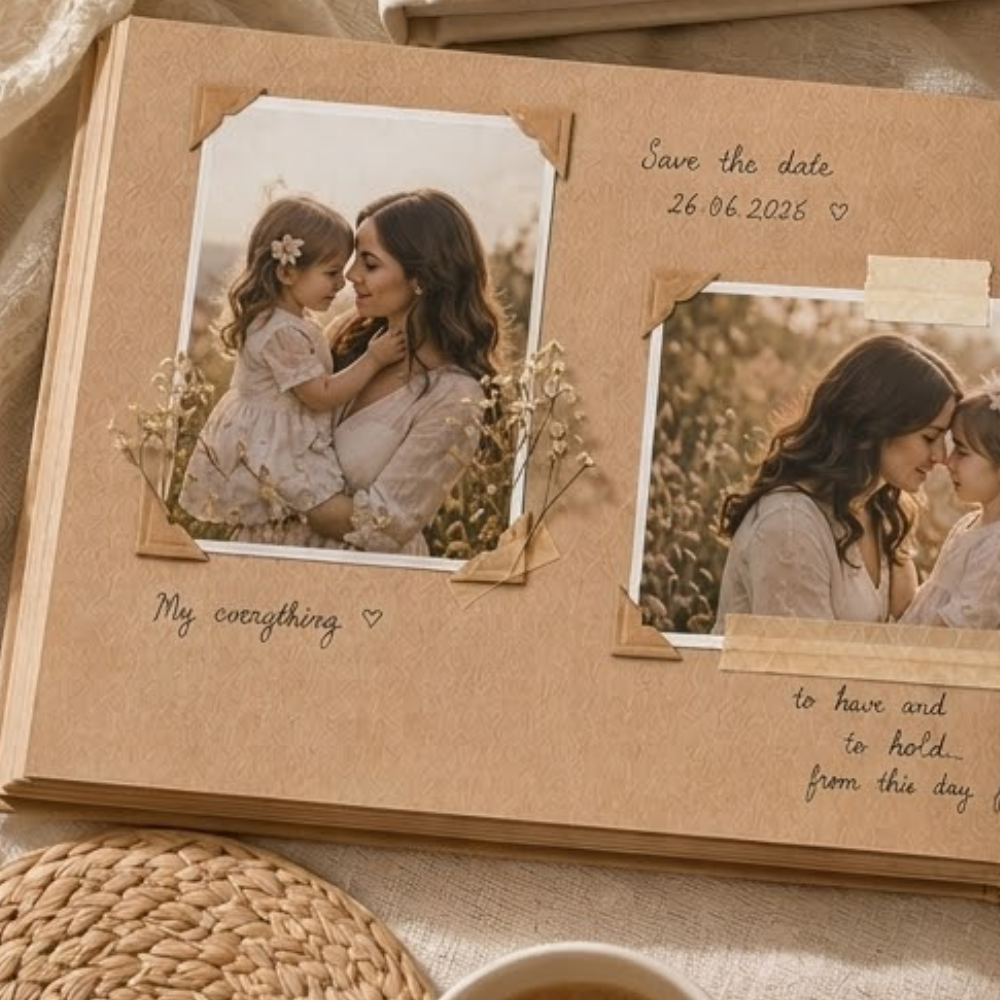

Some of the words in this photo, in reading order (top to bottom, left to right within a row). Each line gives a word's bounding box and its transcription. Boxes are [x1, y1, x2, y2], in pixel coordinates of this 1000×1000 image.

[641, 137, 700, 170] Save
[719, 144, 758, 175] the
[777, 150, 834, 176] date
[152, 592, 196, 638] My
[792, 686, 815, 709] to
[834, 685, 886, 713] have
[901, 692, 947, 715] and
[843, 732, 868, 755] to
[804, 764, 861, 802] from
[932, 773, 974, 813] day
